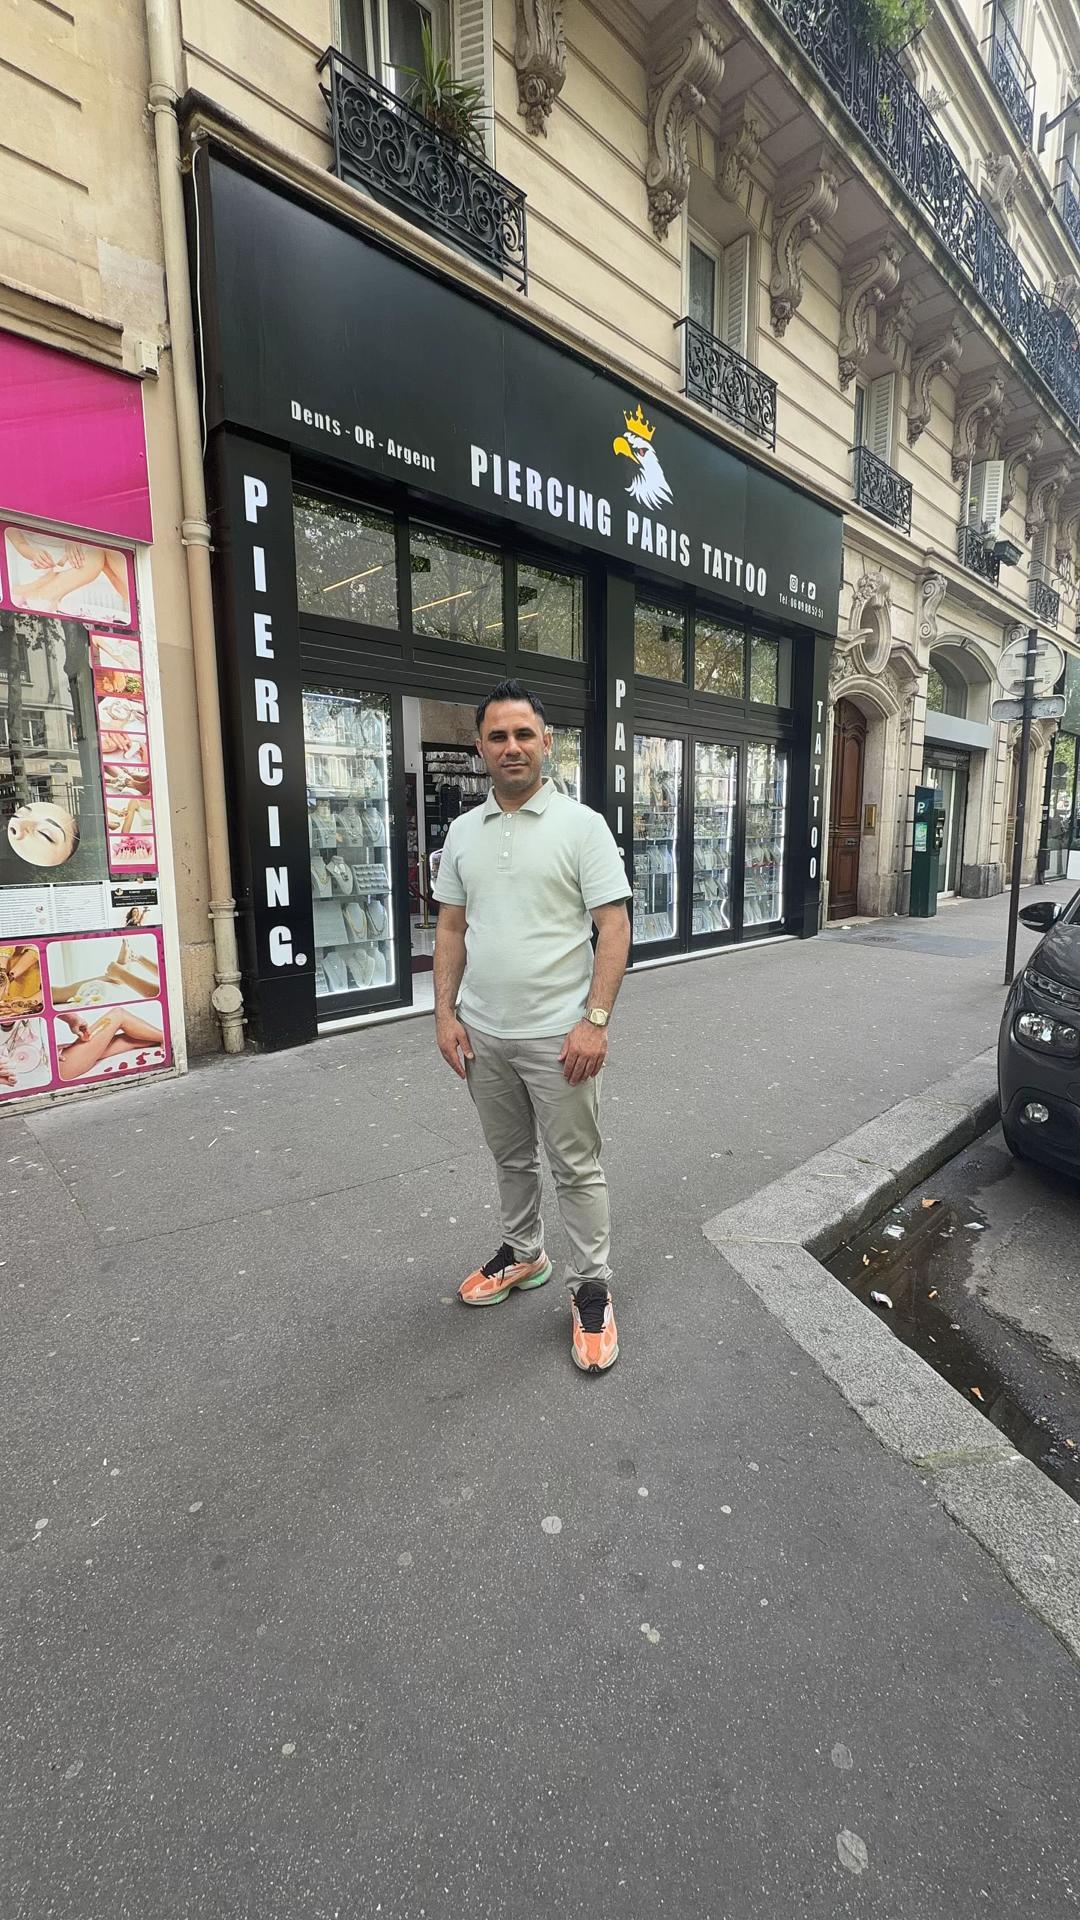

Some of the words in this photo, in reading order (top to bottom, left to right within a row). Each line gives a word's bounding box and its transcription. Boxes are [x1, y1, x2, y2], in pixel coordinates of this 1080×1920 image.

[290, 400, 342, 436] Dents
[354, 425, 375, 449] OR
[387, 439, 436, 472] Argent
[470, 444, 613, 538] PIERCING
[626, 509, 690, 568] PARIS
[702, 542, 767, 598] TATTOO
[809, 700, 824, 879] TATTOO
